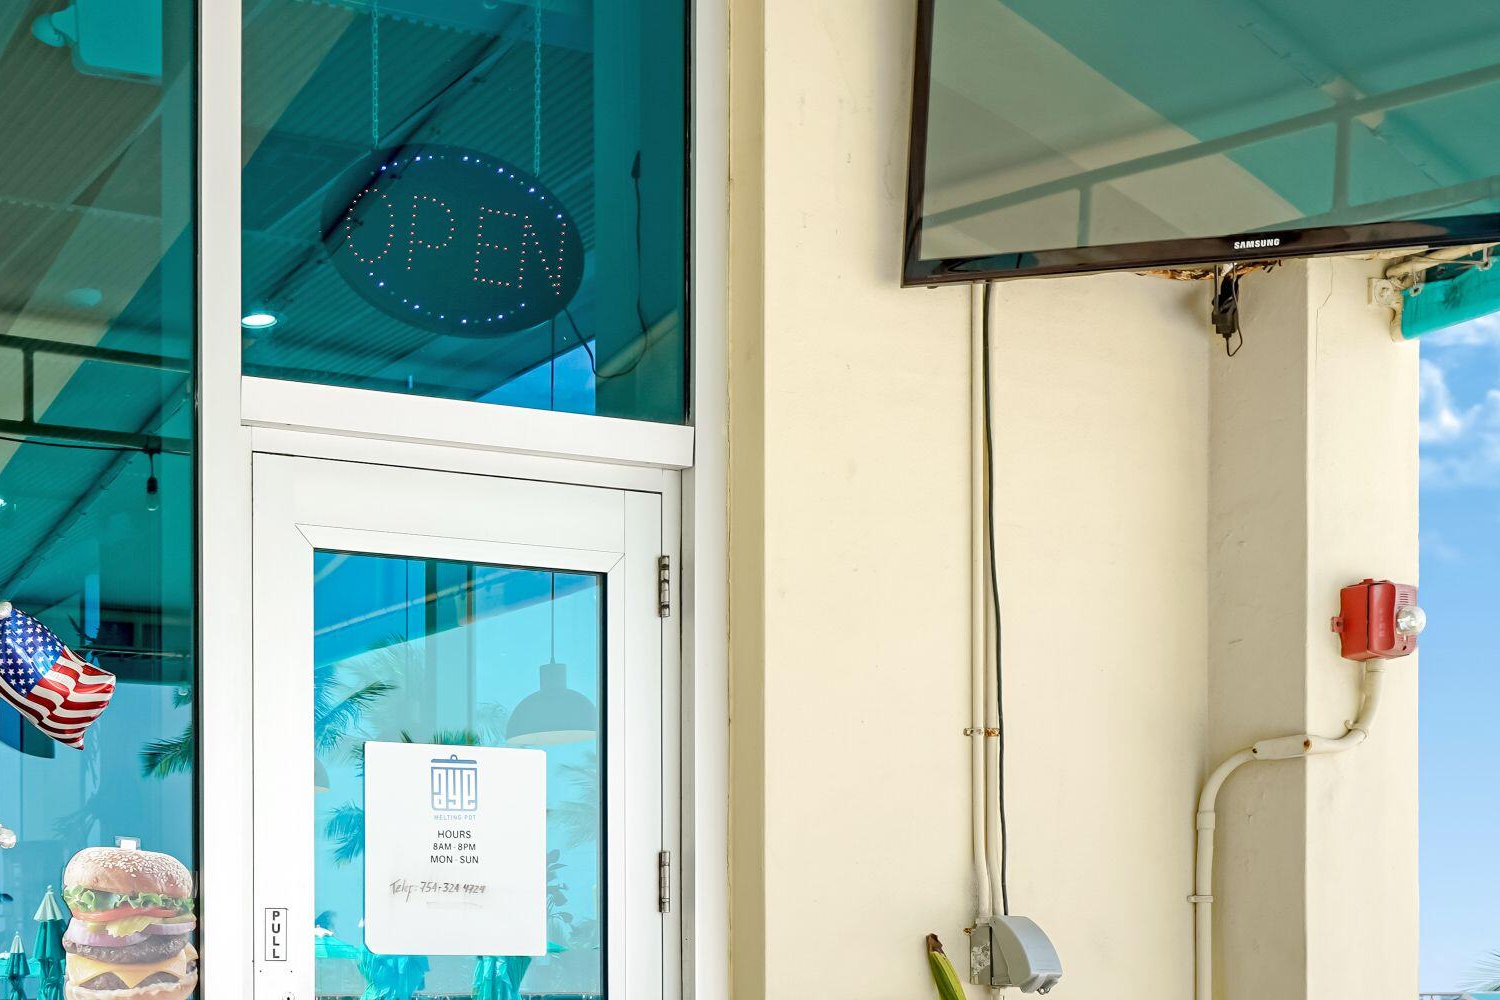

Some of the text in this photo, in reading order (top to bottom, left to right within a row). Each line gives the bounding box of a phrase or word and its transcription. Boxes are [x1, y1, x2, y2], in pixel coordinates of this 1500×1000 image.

[345, 187, 567, 295] OPEN
[1234, 238, 1280, 249] SAMSUNG
[437, 830, 472, 839] HOURS
[433, 842, 452, 851] 8AM
[457, 843, 476, 851] 8PM
[430, 855, 453, 864] MON
[459, 855, 479, 864] SUN
[271, 910, 281, 959] PULL
